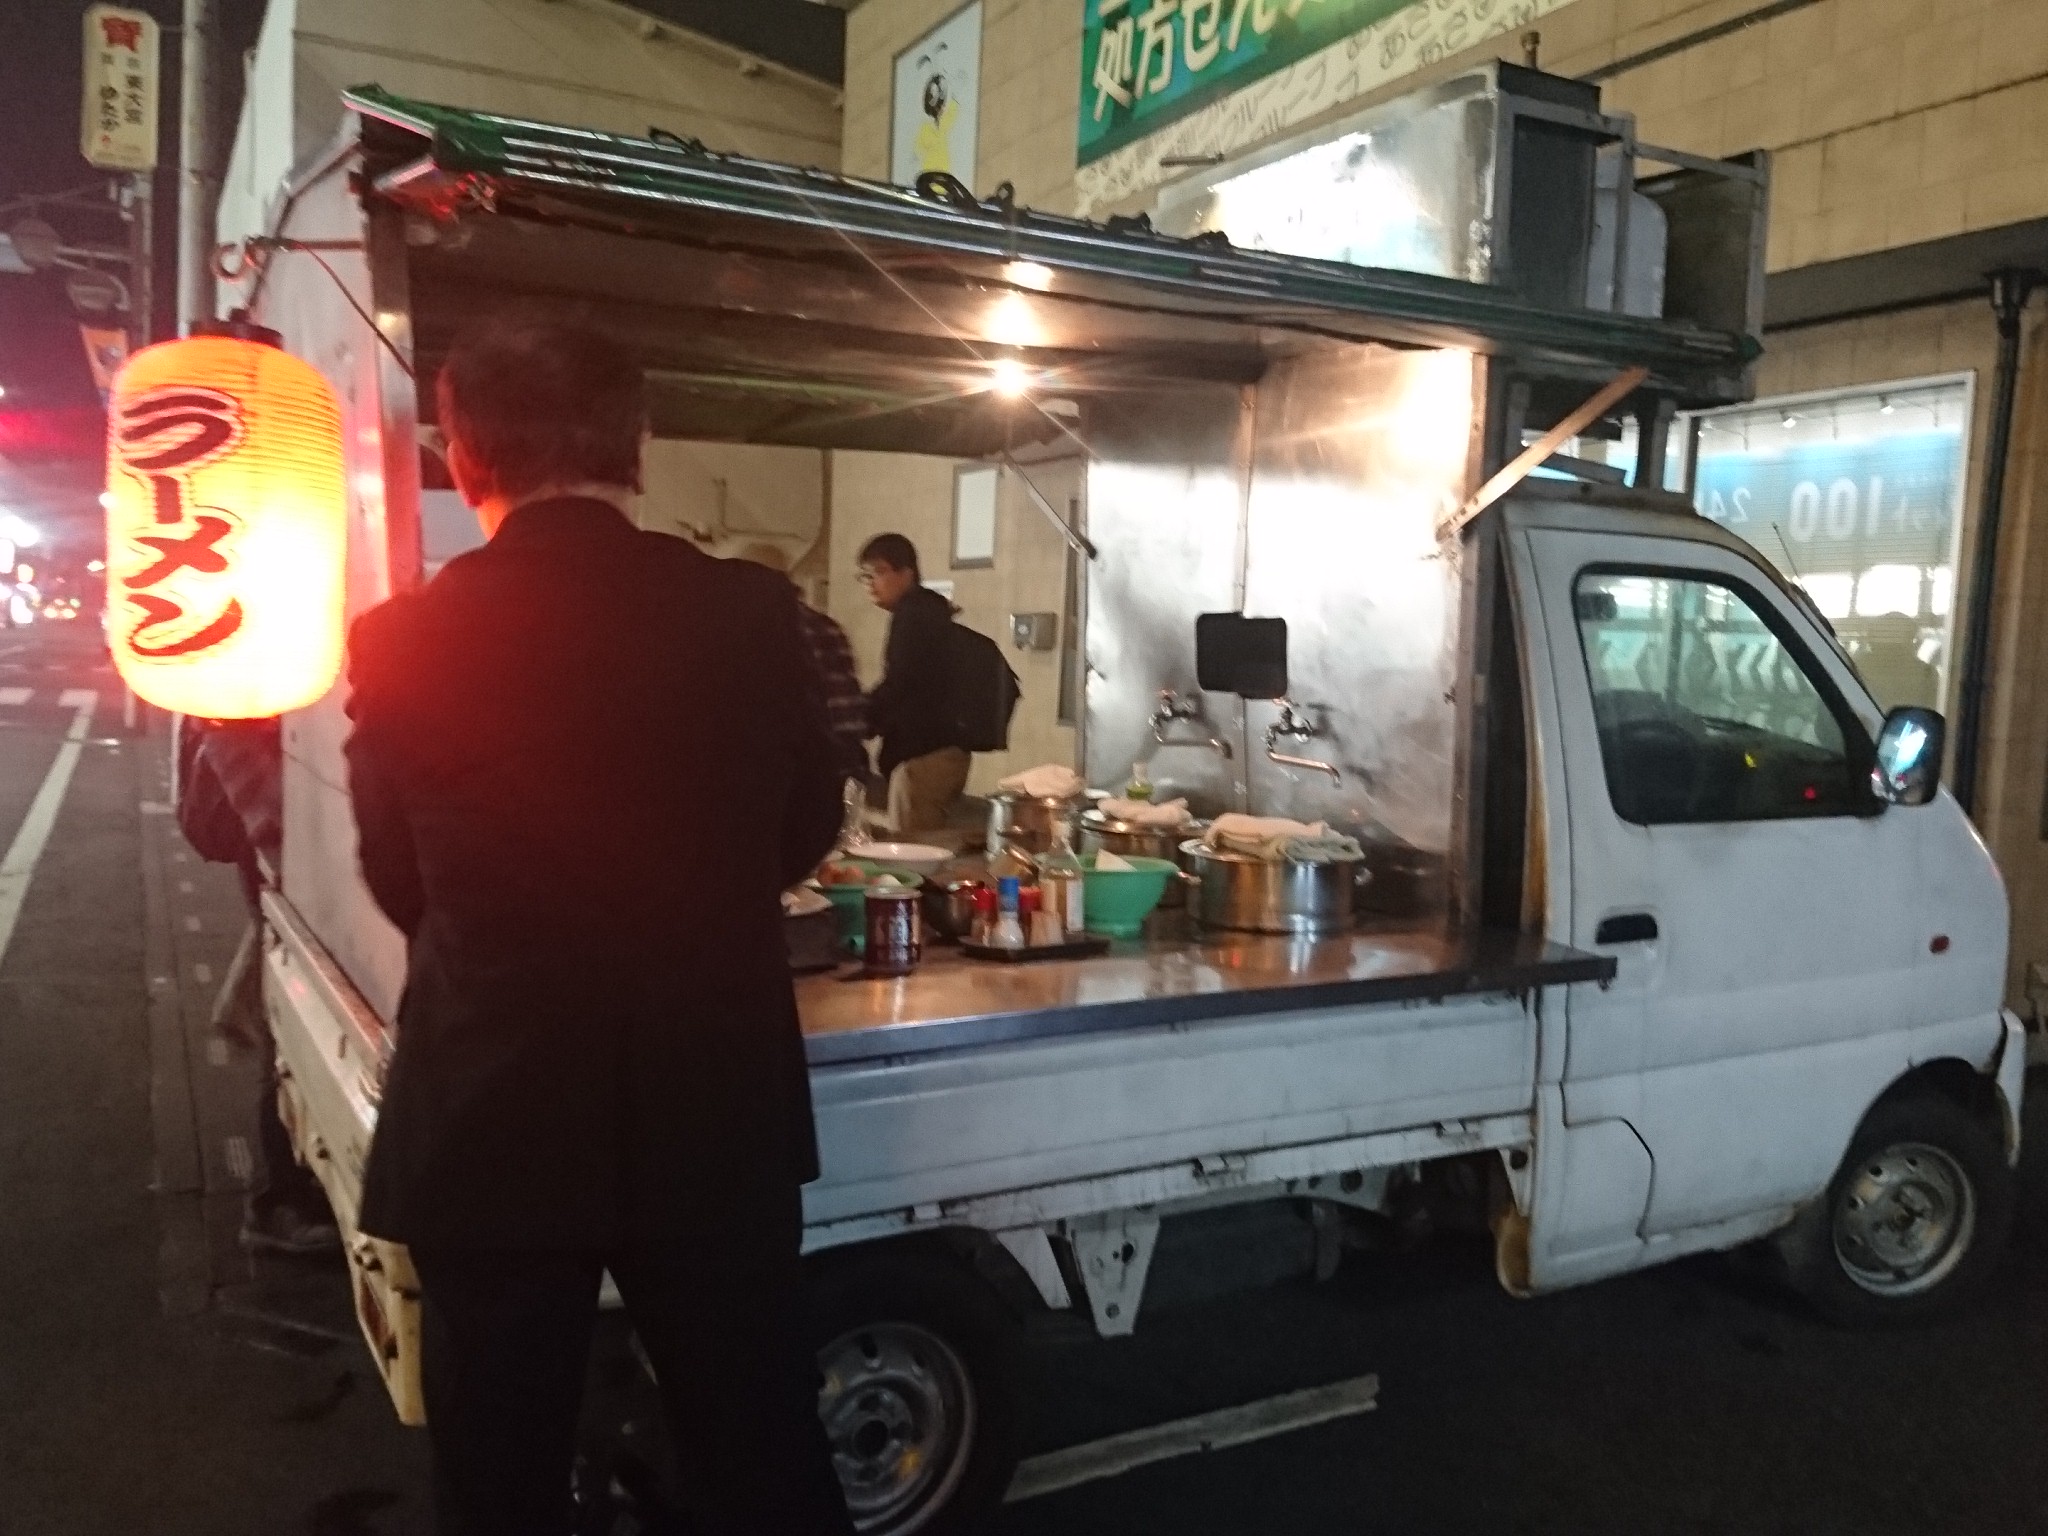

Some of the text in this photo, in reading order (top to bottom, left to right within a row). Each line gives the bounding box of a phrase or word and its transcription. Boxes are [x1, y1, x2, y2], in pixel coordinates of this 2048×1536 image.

[1093, 0, 1328, 121] 処方せん
[118, 391, 245, 658] ラーメン
